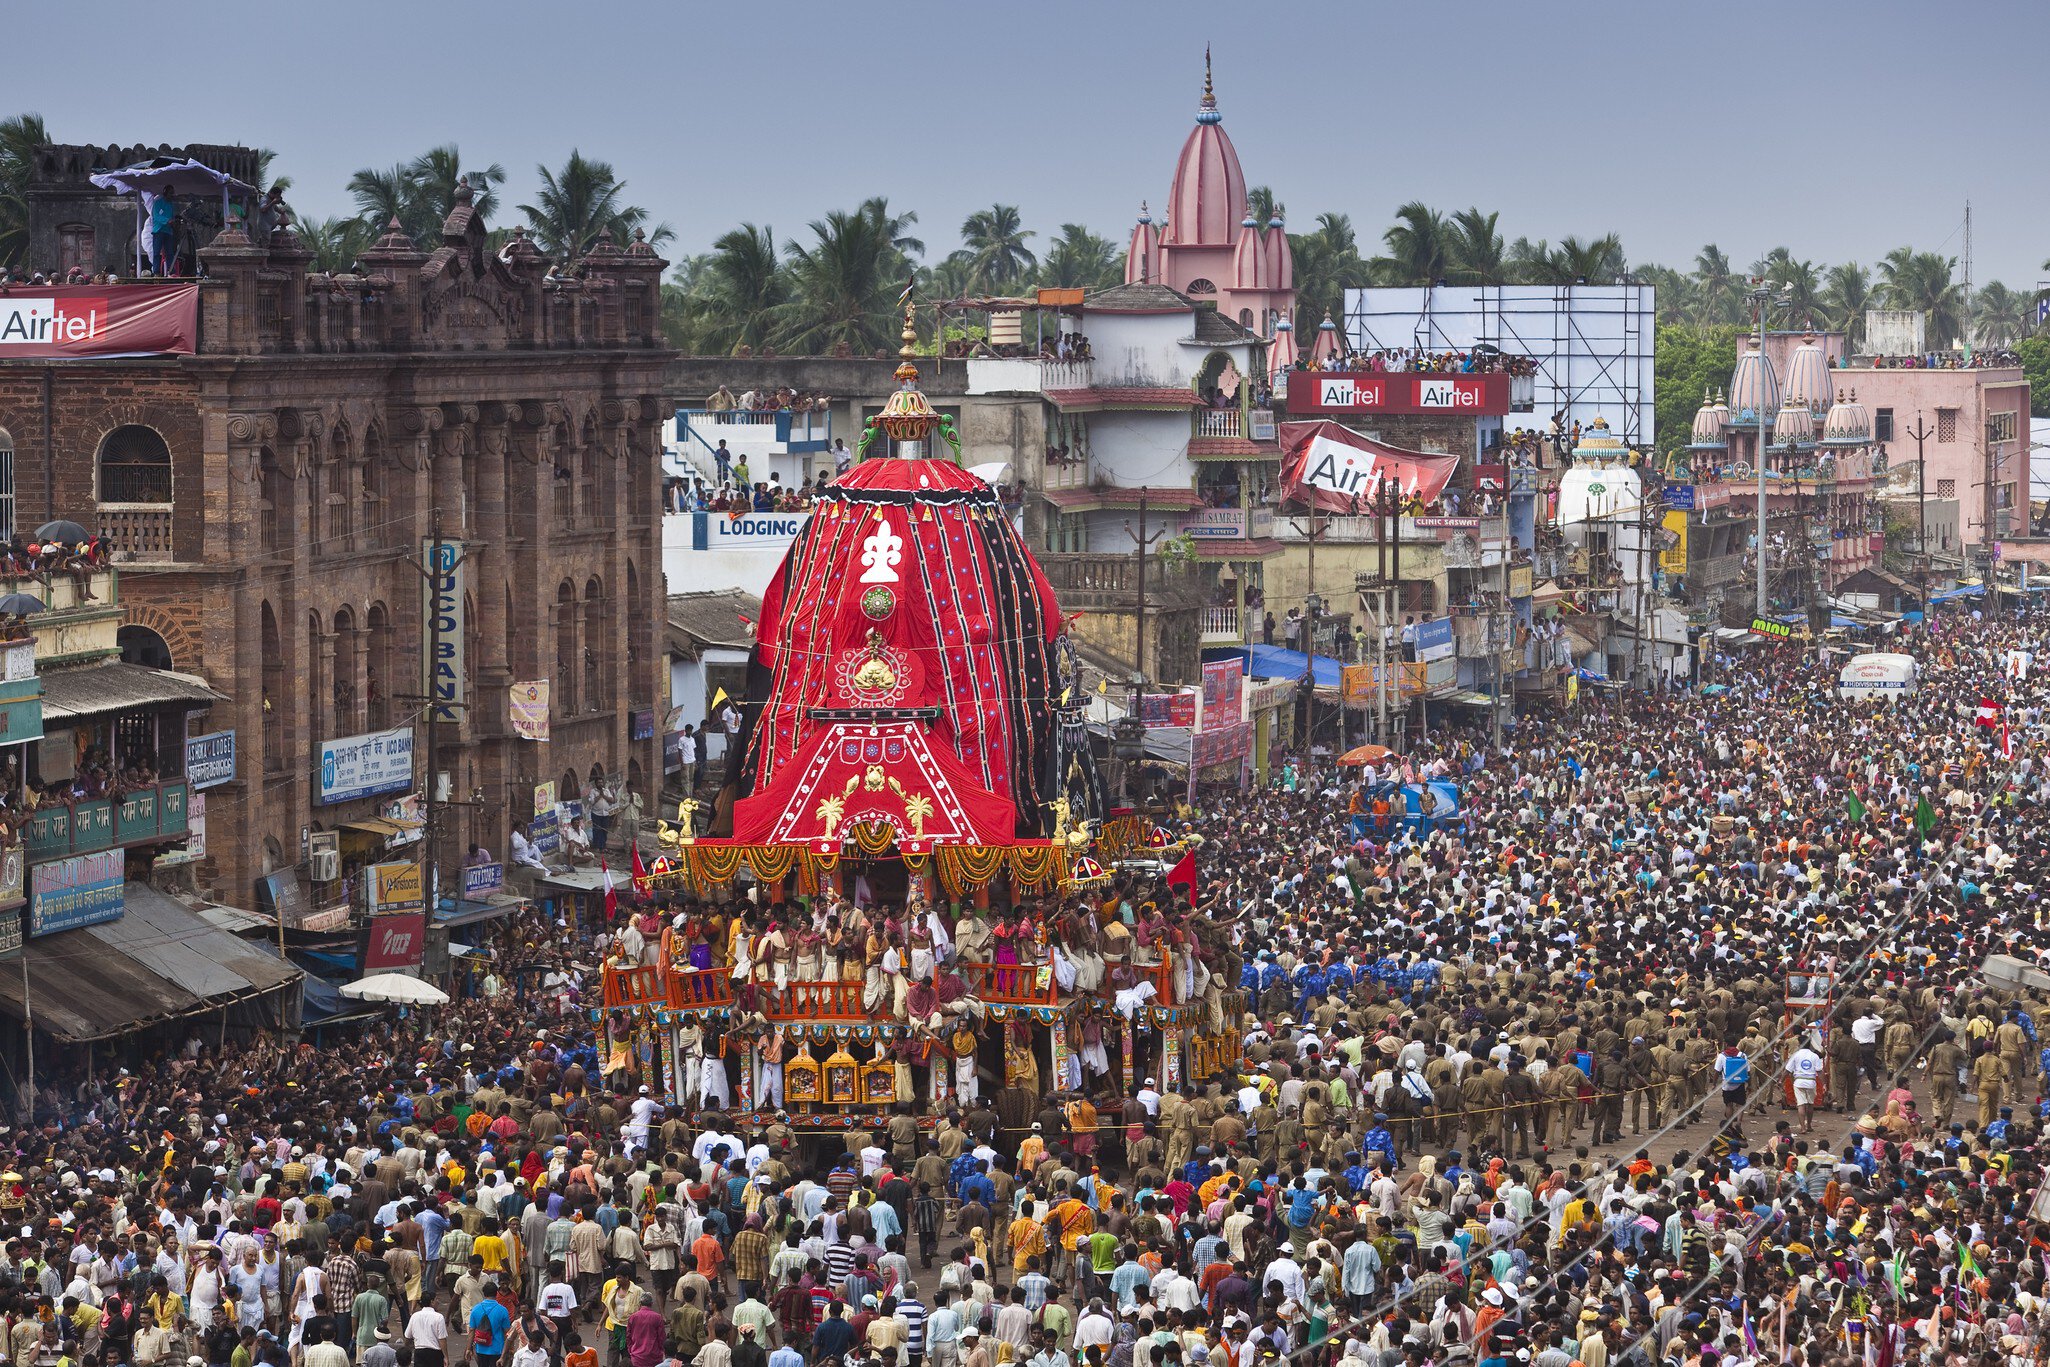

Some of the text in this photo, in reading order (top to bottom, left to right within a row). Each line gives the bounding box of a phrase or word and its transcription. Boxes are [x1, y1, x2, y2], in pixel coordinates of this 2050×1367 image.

[1, 309, 96, 341] Airtel
[1324, 385, 1379, 405] Airtel
[1423, 386, 1479, 407] Airtel
[1208, 512, 1243, 524] SAMRAT
[719, 520, 798, 536] LODGING
[428, 576, 457, 633] UCO
[187, 736, 231, 762] ASHOKA LODGE
[386, 737, 412, 756] UCO BANK
[393, 875, 420, 892] Aristocrat
[466, 869, 481, 886] LUCKY
[481, 867, 495, 884] STORE
